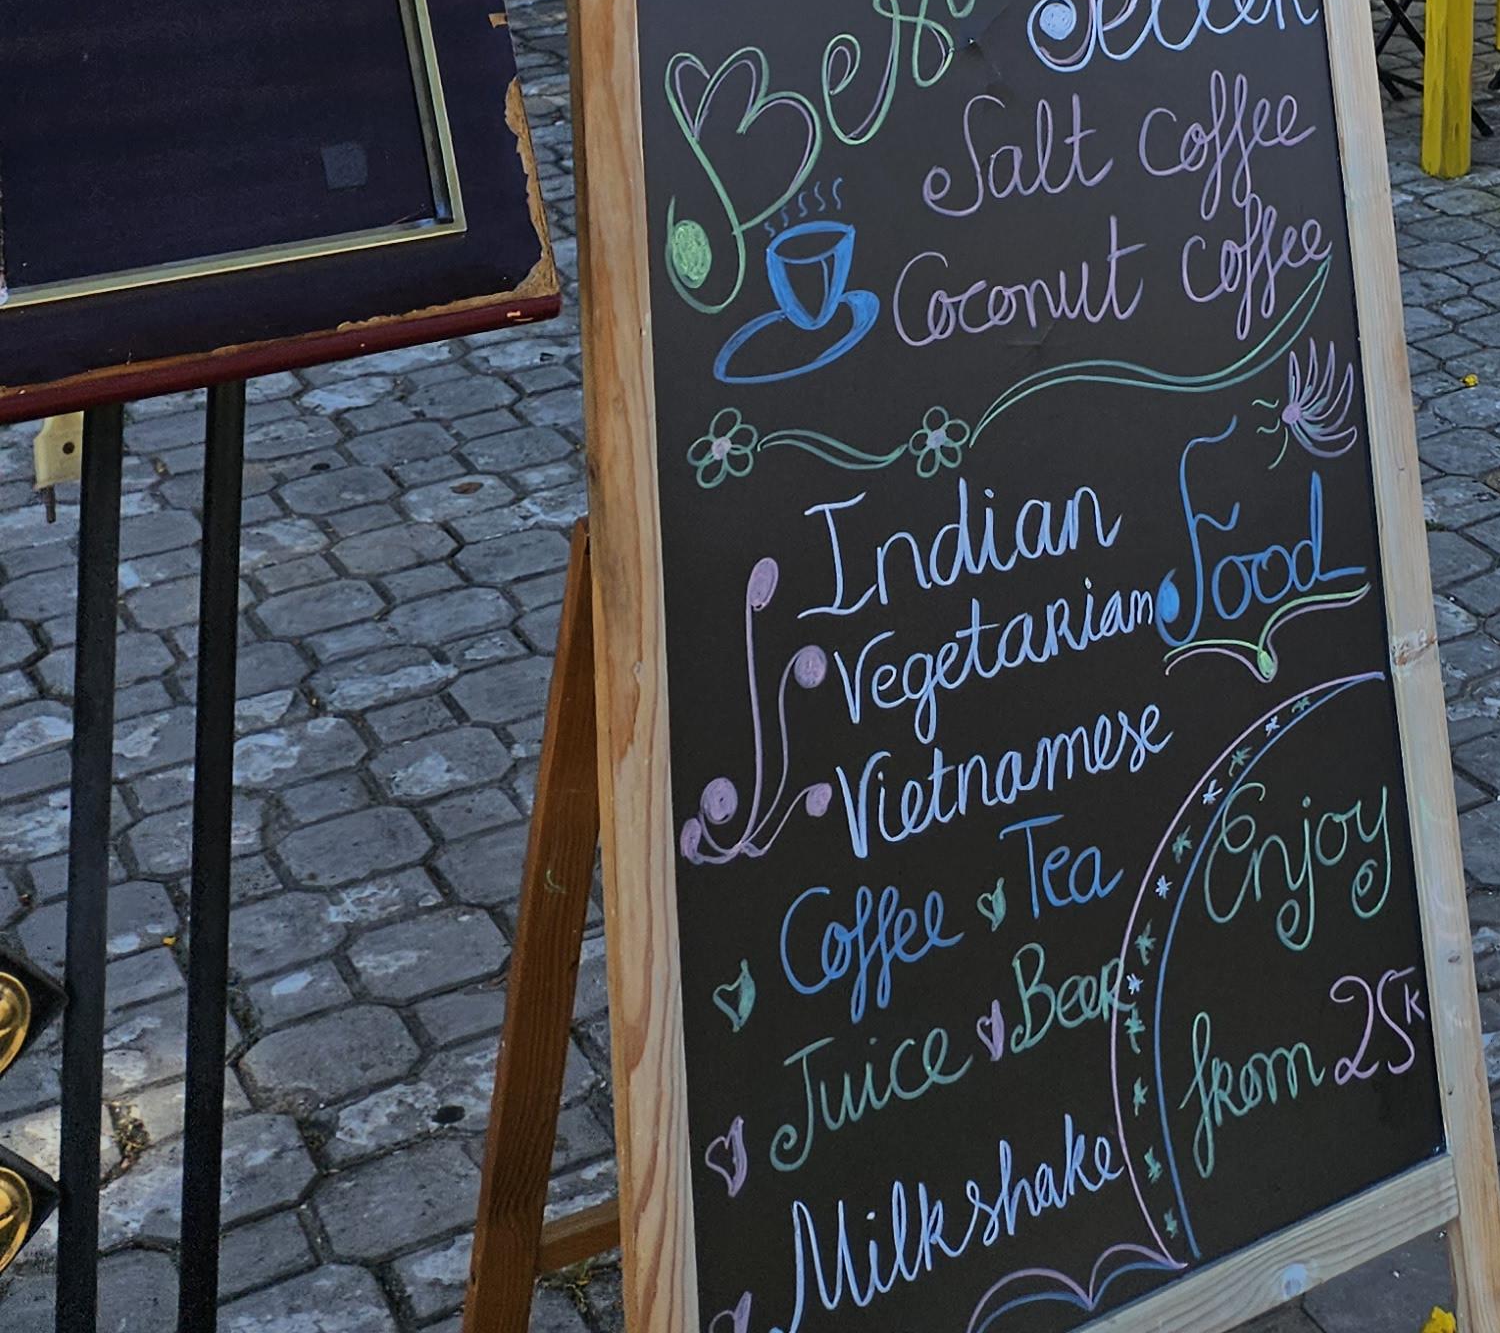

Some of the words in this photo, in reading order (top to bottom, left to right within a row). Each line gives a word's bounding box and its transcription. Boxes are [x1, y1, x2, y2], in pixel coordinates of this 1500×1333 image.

[922, 94, 1113, 216] Salt
[893, 215, 1147, 347] Coconut
[796, 477, 1122, 620] Indian
[833, 576, 1155, 744] Vegetarian
[836, 704, 1173, 858] Vietnamese
[779, 886, 965, 1023] Coffee
[1000, 814, 1124, 919] Tea
[1203, 782, 1391, 951] Enjoy
[769, 1028, 974, 1172] Juice
[1010, 943, 1134, 1053] Beer
[1178, 1011, 1326, 1179] from
[768, 1113, 1127, 1333] Milkshake
